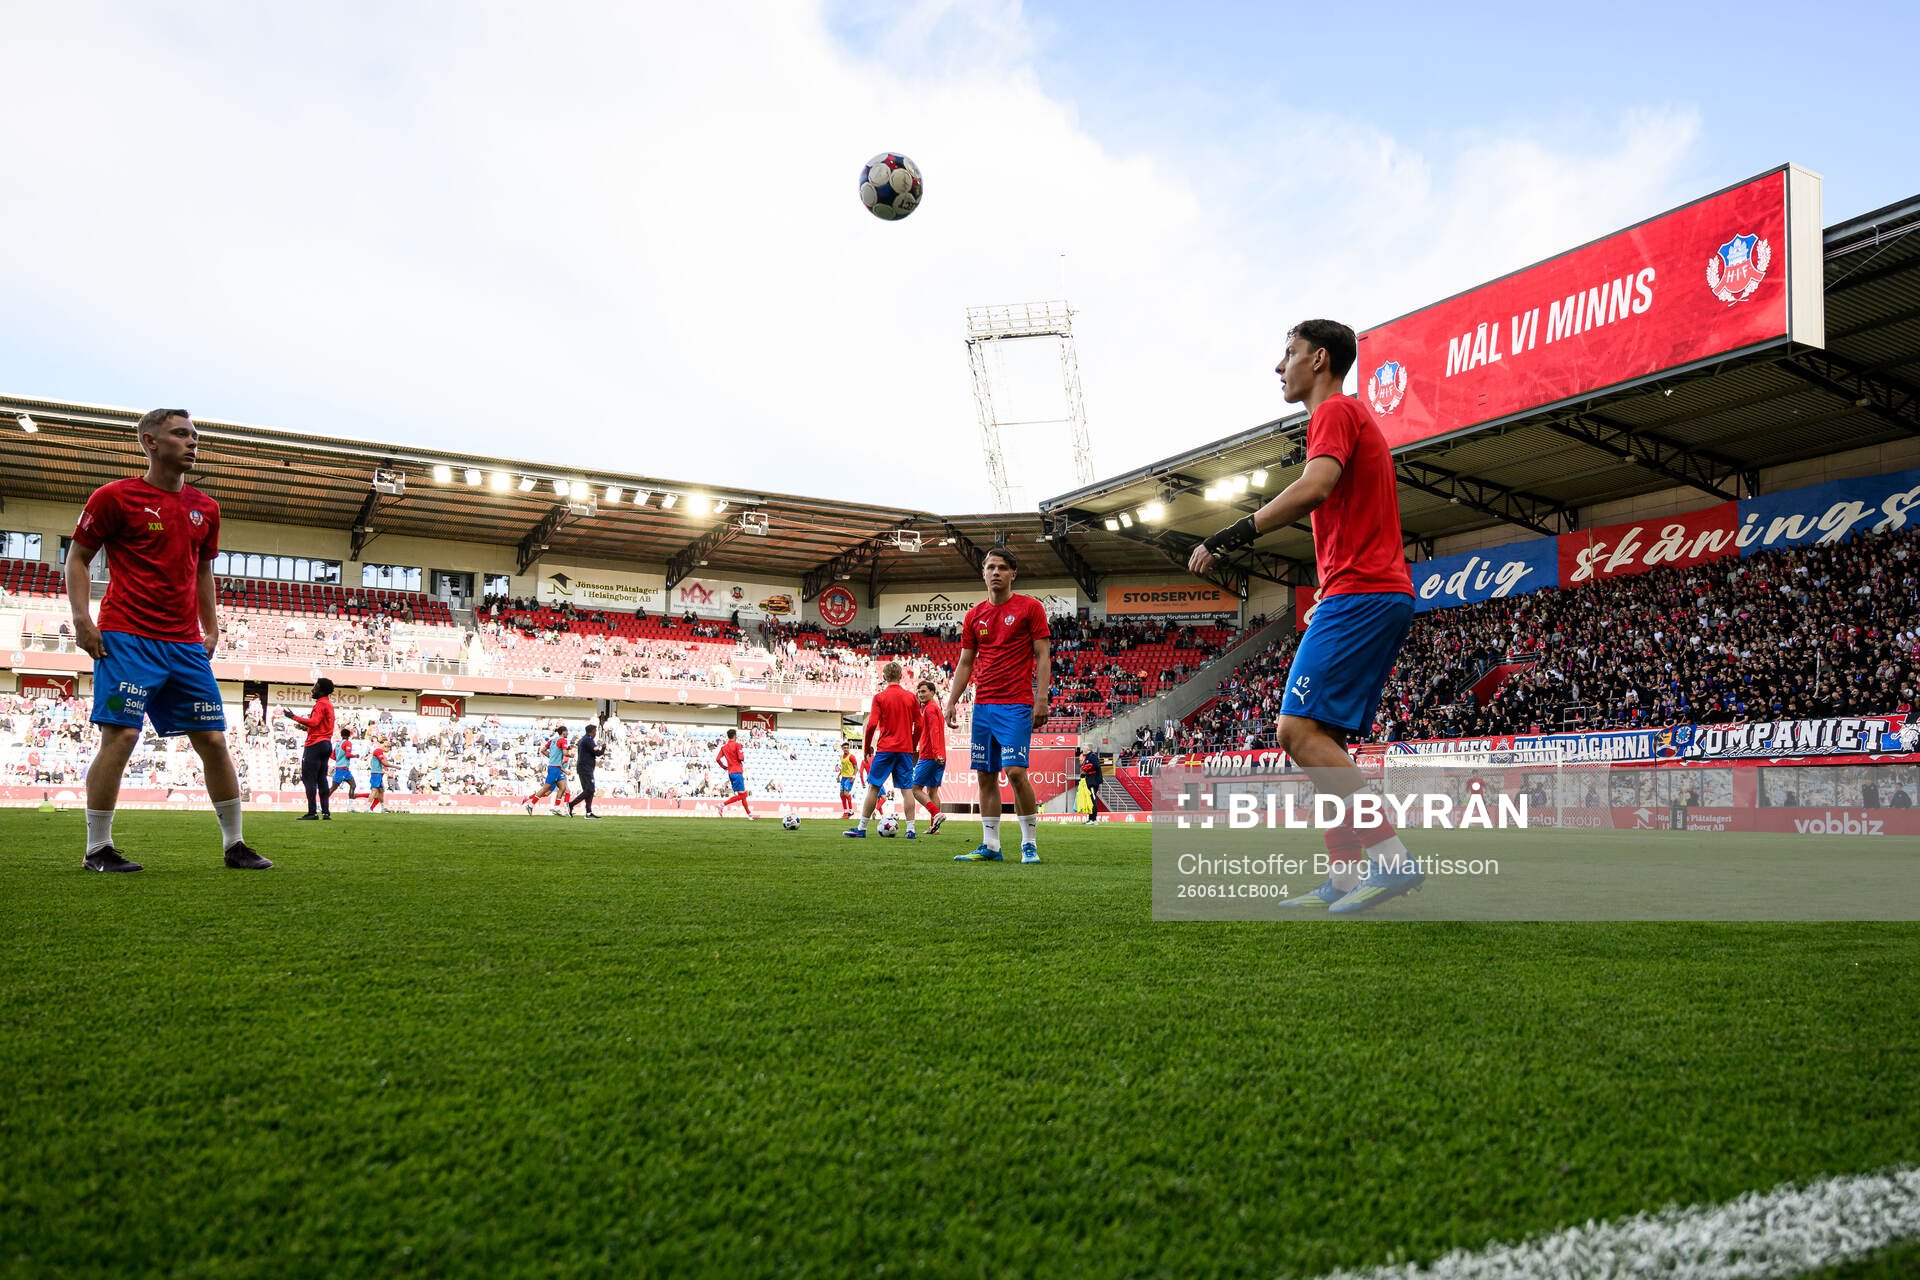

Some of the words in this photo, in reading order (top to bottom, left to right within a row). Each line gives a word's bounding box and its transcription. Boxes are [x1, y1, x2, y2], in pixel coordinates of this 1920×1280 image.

[1446, 322, 1502, 377] MÅL
[1511, 310, 1539, 356] VI
[1545, 267, 1655, 344] MINNS
[148, 522, 164, 531] XXL
[1411, 555, 1533, 601] edig
[575, 581, 614, 591] Jönssons
[589, 590, 637, 603] Helsingborg
[681, 582, 715, 604] MAX
[1123, 590, 1221, 603] STORSERVICE
[905, 602, 974, 613] ANDERSSONS
[926, 612, 953, 621] BYGG
[1296, 676, 1310, 688] 42
[119, 682, 148, 697] Fibio
[194, 702, 221, 712] Fibio
[421, 705, 451, 717] PUMA
[1684, 719, 1888, 758] KOMPANIET
[1203, 751, 1253, 777] SÖDRA
[1690, 814, 1732, 824] Plåtslageri
[1794, 812, 1884, 836] vobbiz
